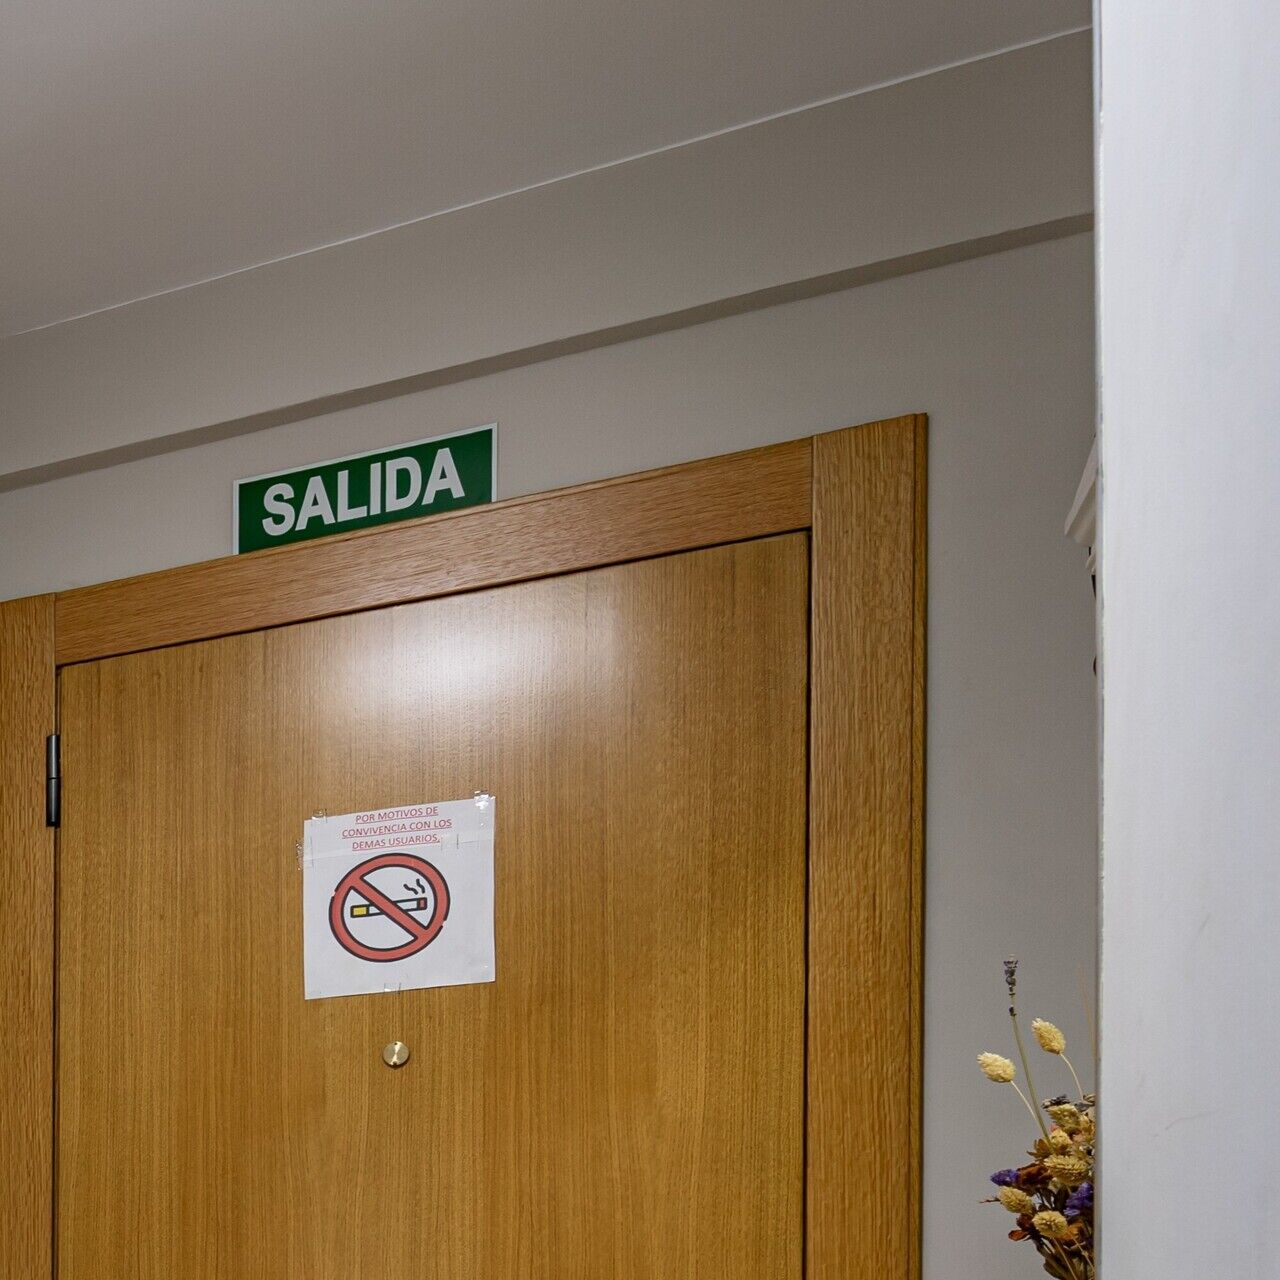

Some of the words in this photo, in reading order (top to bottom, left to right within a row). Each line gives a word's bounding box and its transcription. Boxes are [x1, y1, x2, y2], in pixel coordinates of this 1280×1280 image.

[262, 447, 466, 536] SALIDA
[355, 813, 375, 824] POR
[378, 807, 423, 820] MOTIVOS
[425, 806, 439, 816] DE
[342, 823, 407, 838] CONVIVENCIA
[409, 821, 431, 831] CON
[434, 818, 452, 829] LOS
[352, 839, 386, 850] DEMAS
